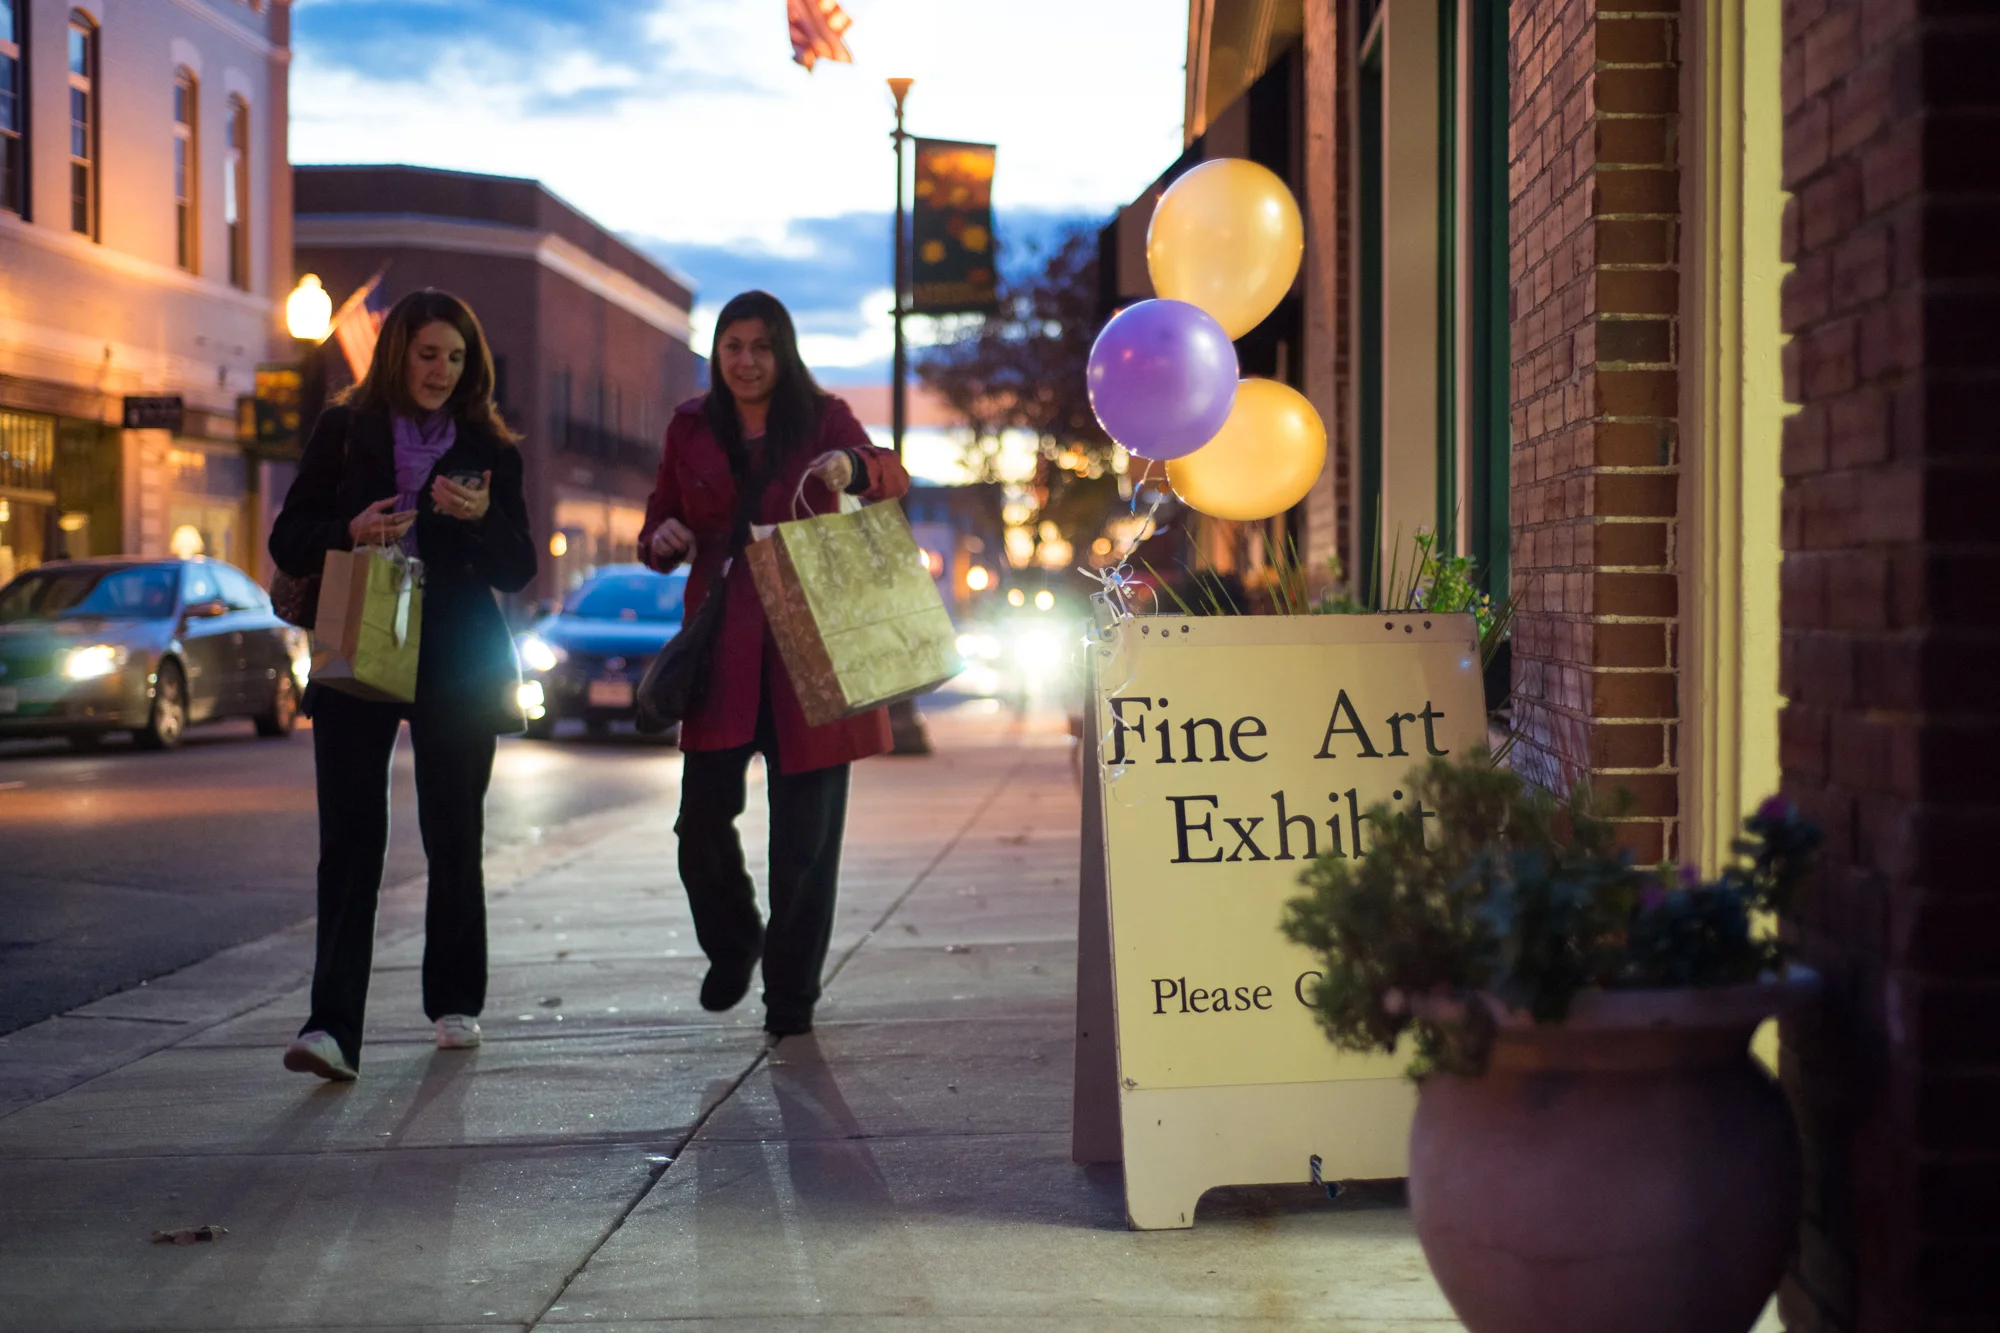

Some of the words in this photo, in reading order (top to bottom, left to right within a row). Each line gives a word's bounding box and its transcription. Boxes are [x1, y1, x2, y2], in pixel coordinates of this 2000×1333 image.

[1106, 697, 1268, 765] Fine
[1313, 688, 1450, 759] Art
[1151, 976, 1273, 1015] Please
